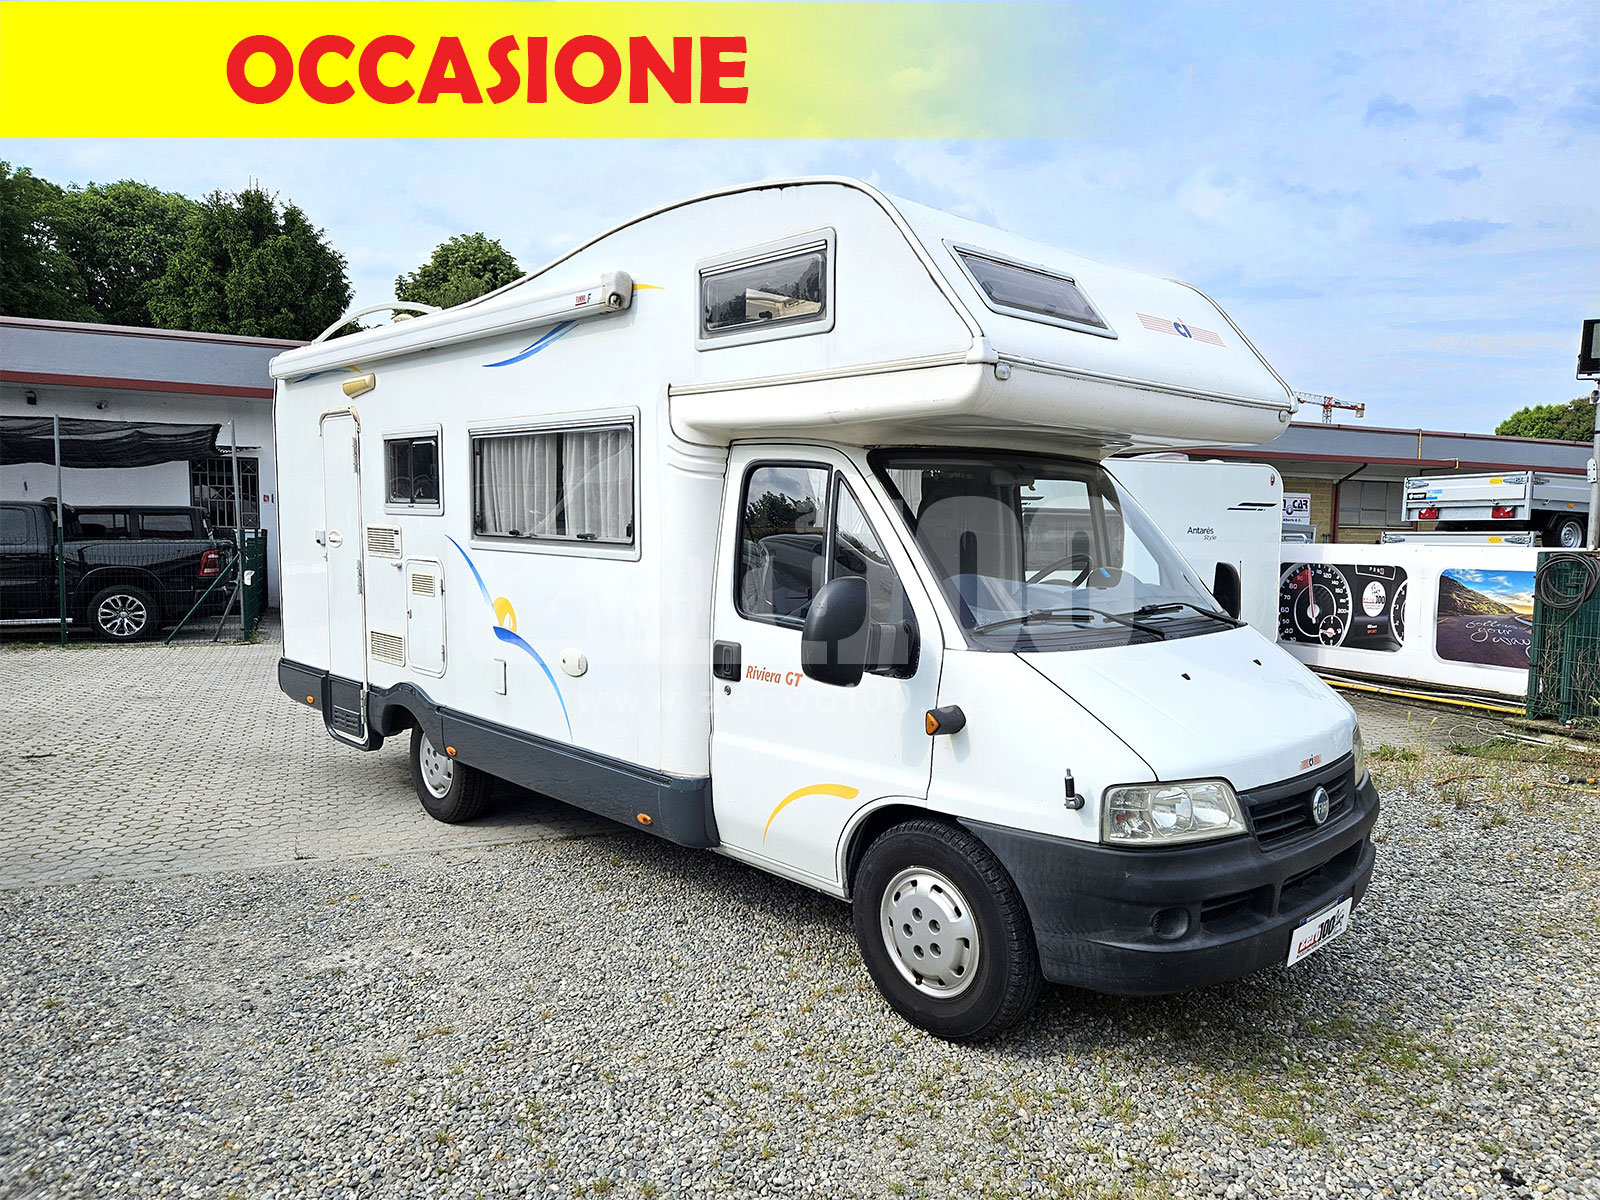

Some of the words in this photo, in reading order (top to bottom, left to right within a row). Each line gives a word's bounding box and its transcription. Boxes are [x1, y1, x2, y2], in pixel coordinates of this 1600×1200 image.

[1292, 499, 1309, 509] CAR
[745, 665, 782, 684] Riviera
[785, 671, 804, 687] GT
